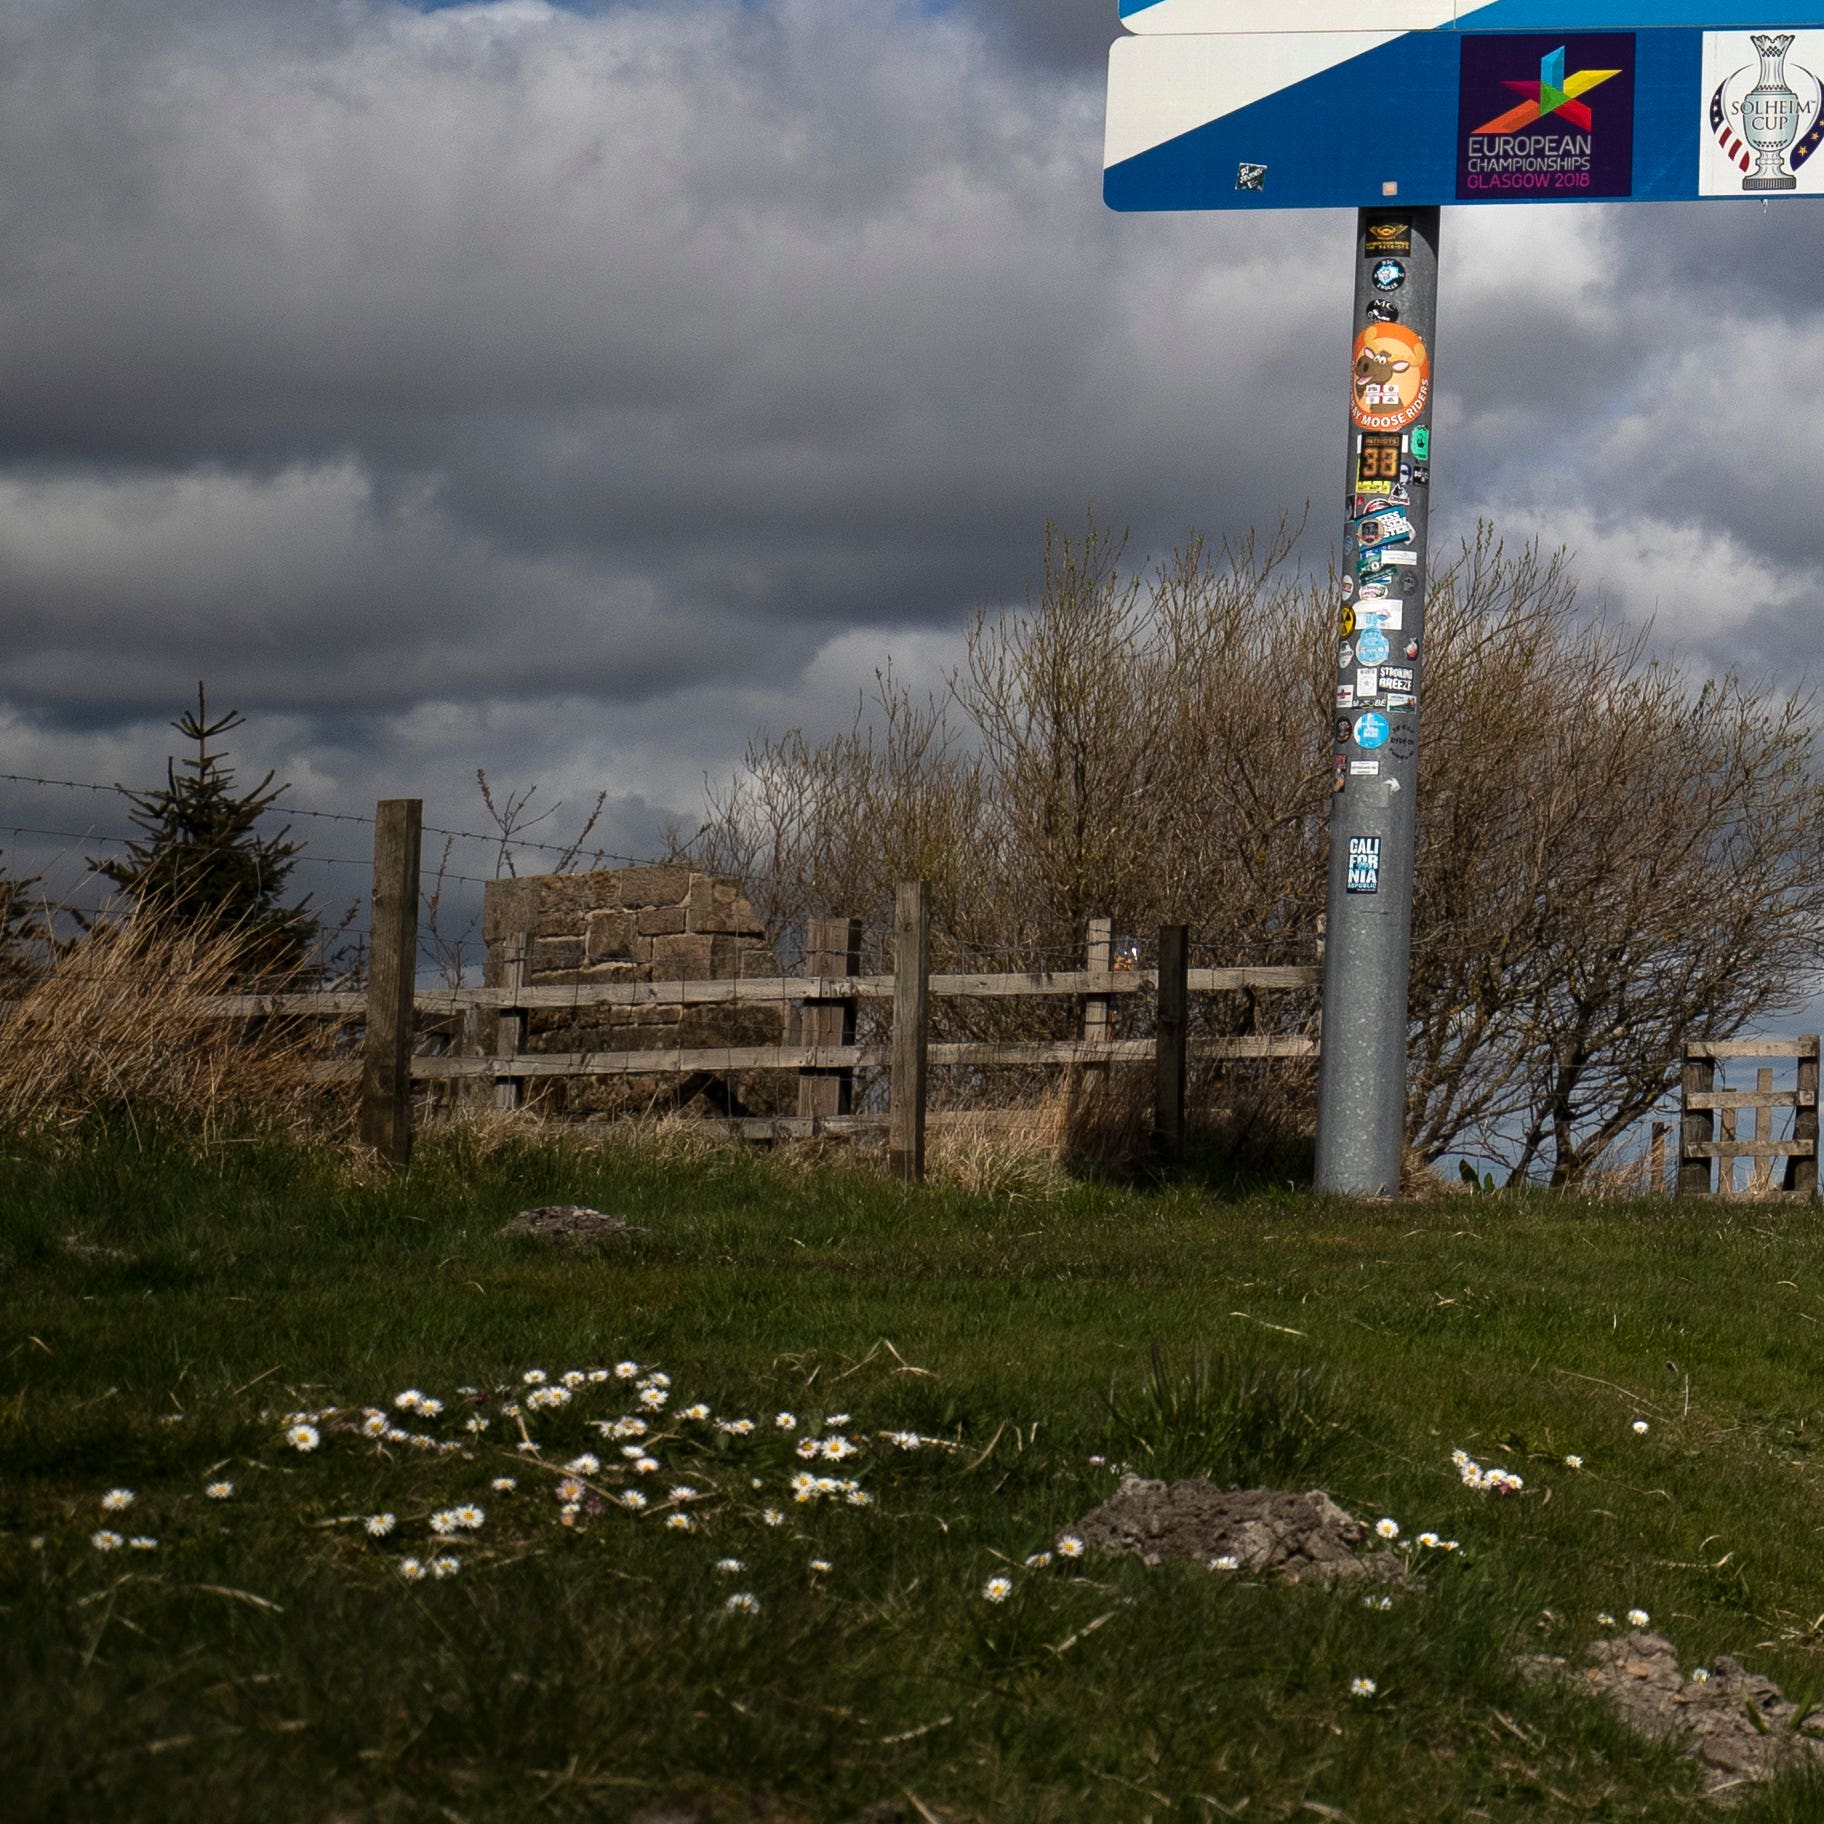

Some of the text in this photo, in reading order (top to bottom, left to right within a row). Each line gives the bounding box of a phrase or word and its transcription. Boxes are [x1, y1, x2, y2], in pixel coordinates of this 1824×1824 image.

[1751, 117, 1788, 130] CUP
[1468, 135, 1592, 157] EUROPEAN
[1467, 156, 1591, 173] CHAMPIONSHIPS
[1467, 172, 1590, 189] GLASGOW 2018
[1361, 412, 1405, 428] MOOSE
[1406, 378, 1429, 418] RIDERS
[1363, 448, 1398, 477] 38
[1350, 838, 1379, 854] CALI
[1349, 854, 1379, 869] FOR
[1347, 868, 1377, 883] NIA
